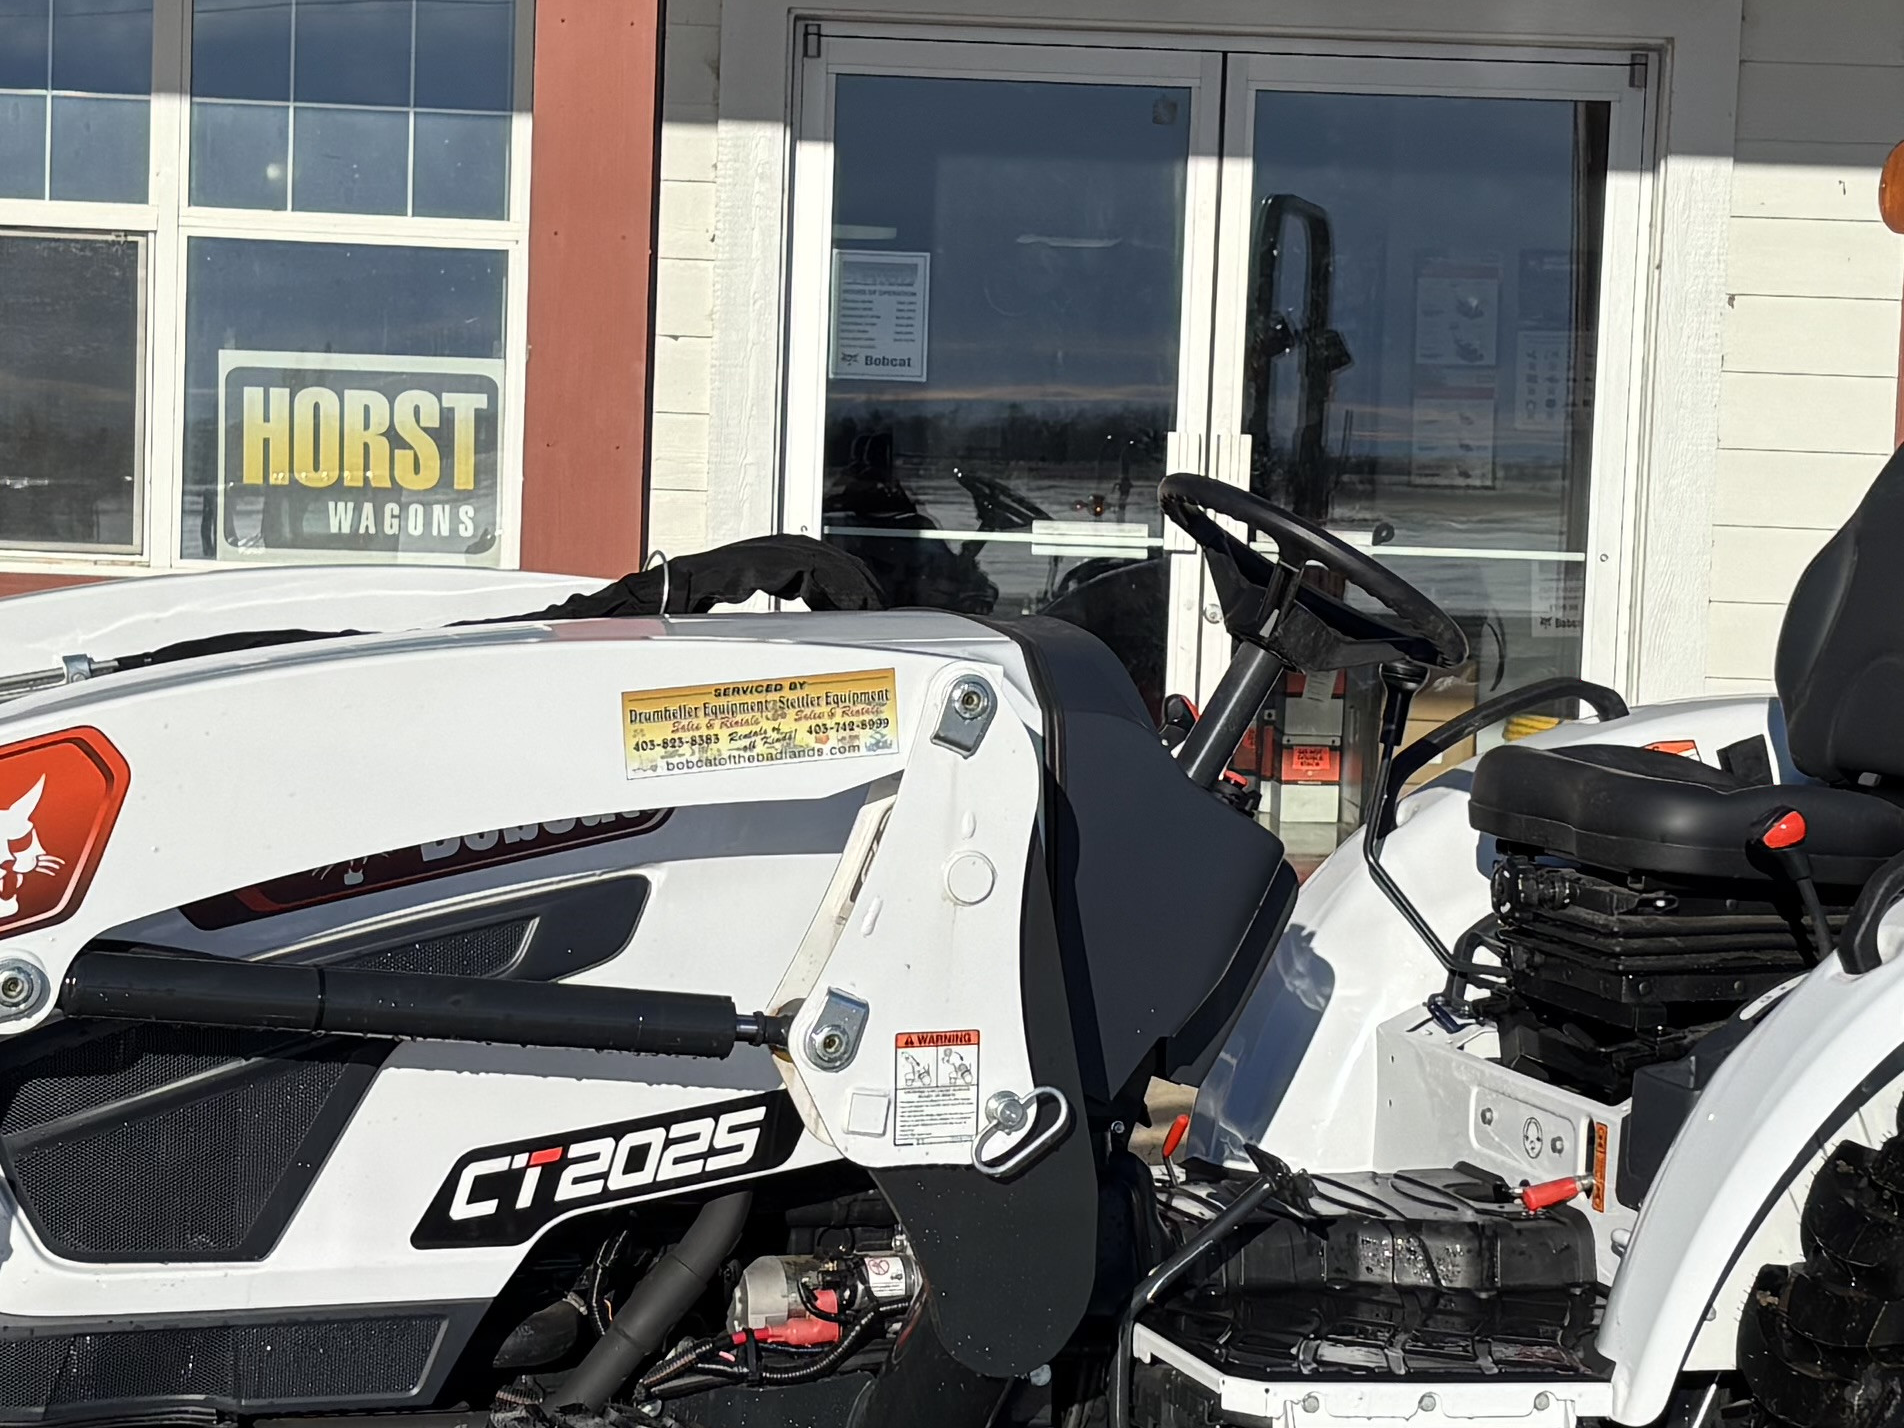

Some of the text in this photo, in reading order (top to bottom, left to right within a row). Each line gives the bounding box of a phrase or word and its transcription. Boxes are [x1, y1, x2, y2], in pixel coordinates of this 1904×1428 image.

[864, 355, 912, 368] Bobcat
[242, 386, 488, 491] HORST
[328, 501, 475, 537] WAGONS
[714, 681, 807, 698] SERVICED BY
[778, 688, 890, 711] Stettler Equipment
[629, 699, 769, 724] Drumheller Equipment
[666, 744, 861, 772] bobcatofthebadlands.com
[916, 1032, 972, 1046] WARNING
[449, 1106, 767, 1221] CT2025
